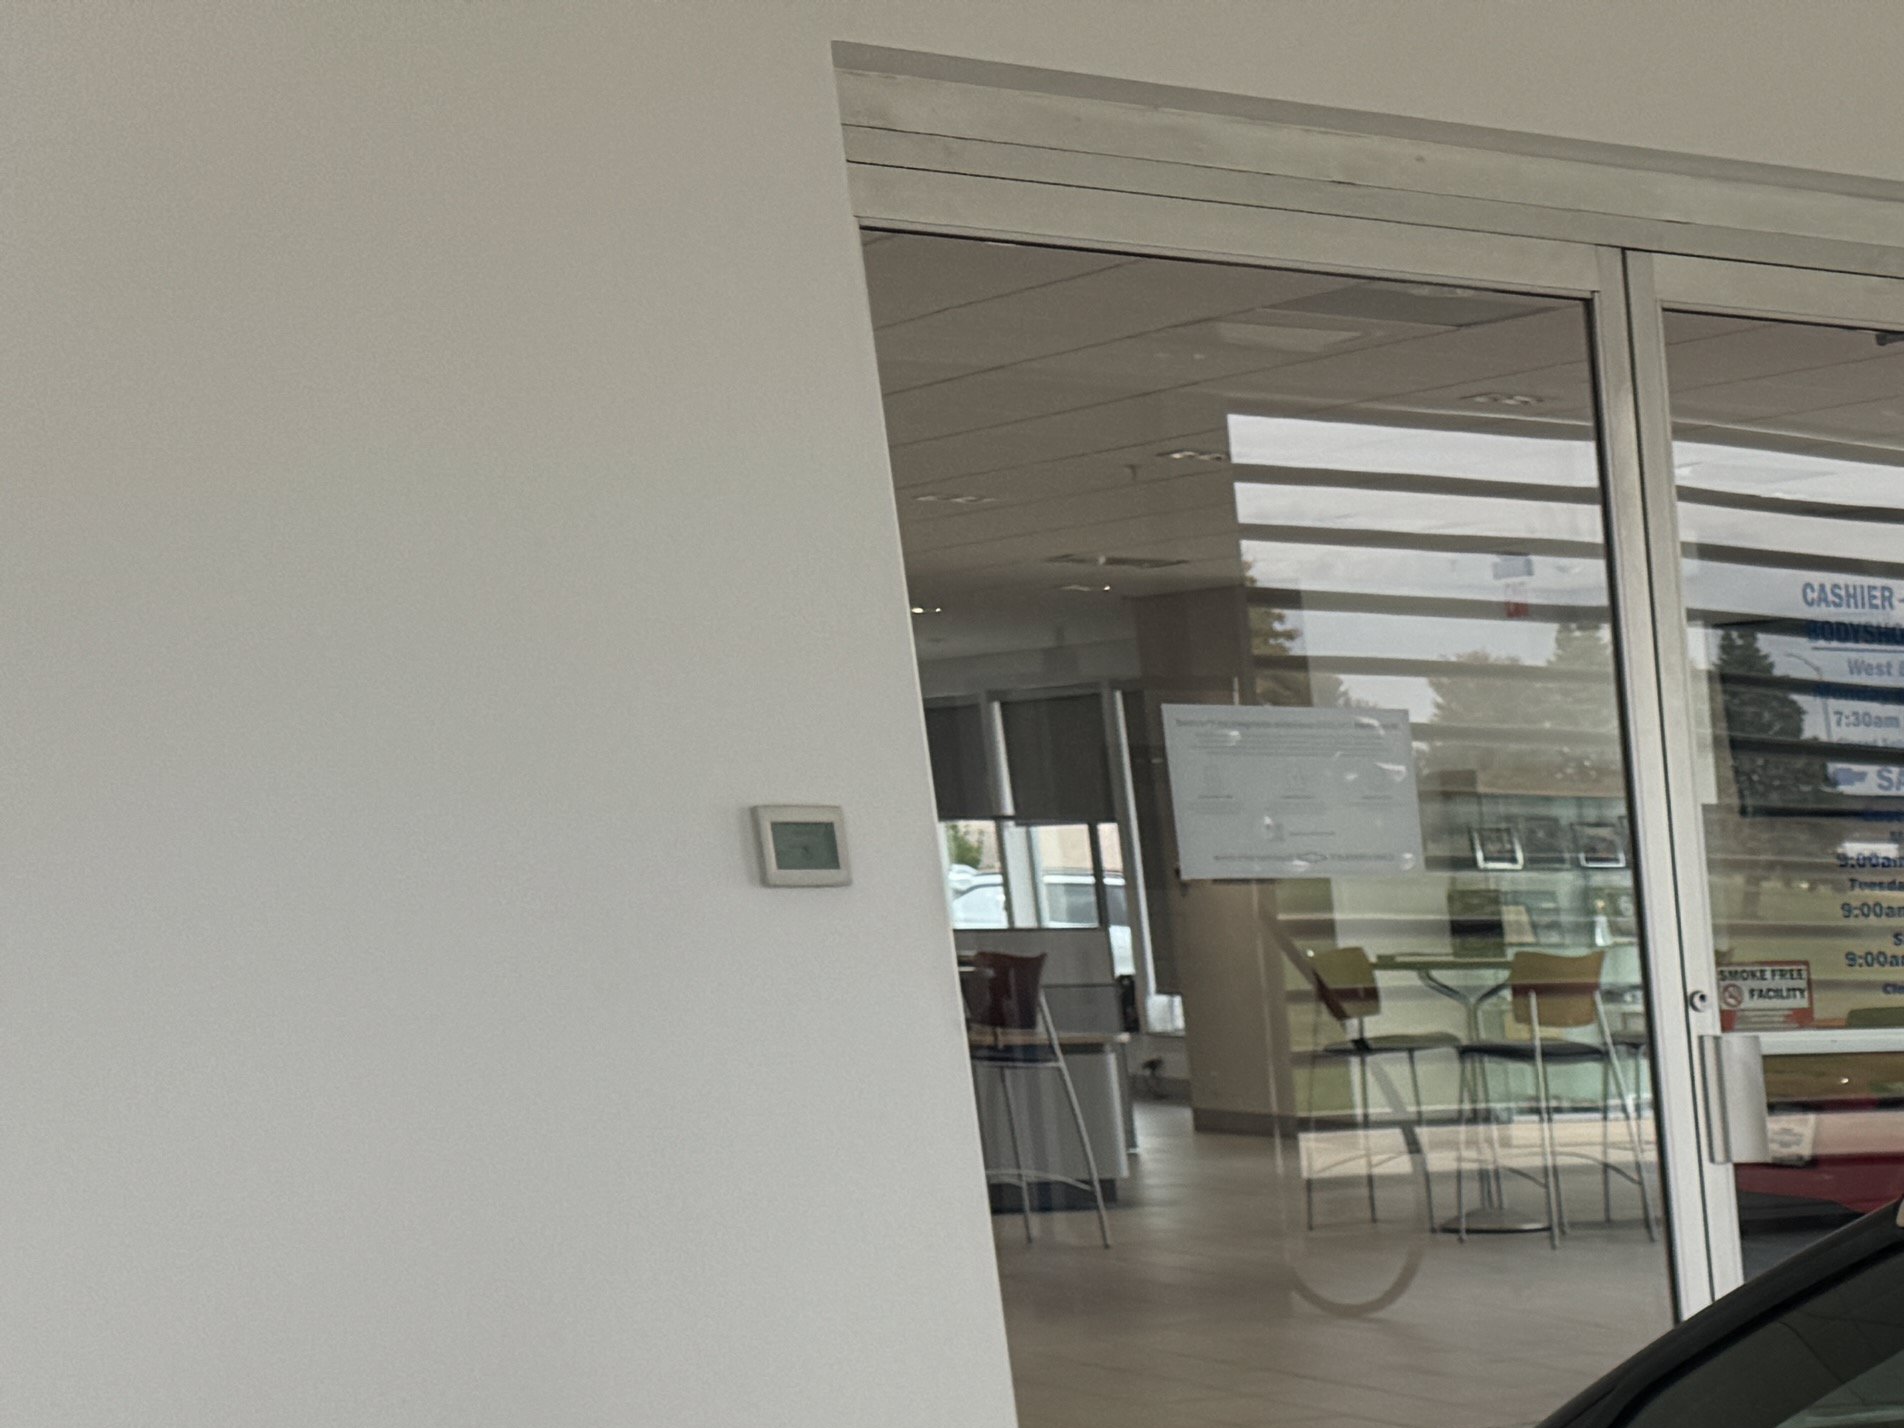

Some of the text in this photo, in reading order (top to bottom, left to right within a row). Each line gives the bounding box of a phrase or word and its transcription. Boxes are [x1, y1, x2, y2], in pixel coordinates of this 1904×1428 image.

[1802, 582, 1895, 610] CASHIER
[1848, 658, 1893, 678] West
[1833, 711, 1898, 729] 7:30am
[1718, 968, 1804, 981] SMOKE FREE
[1748, 987, 1807, 1000] FACILITY
